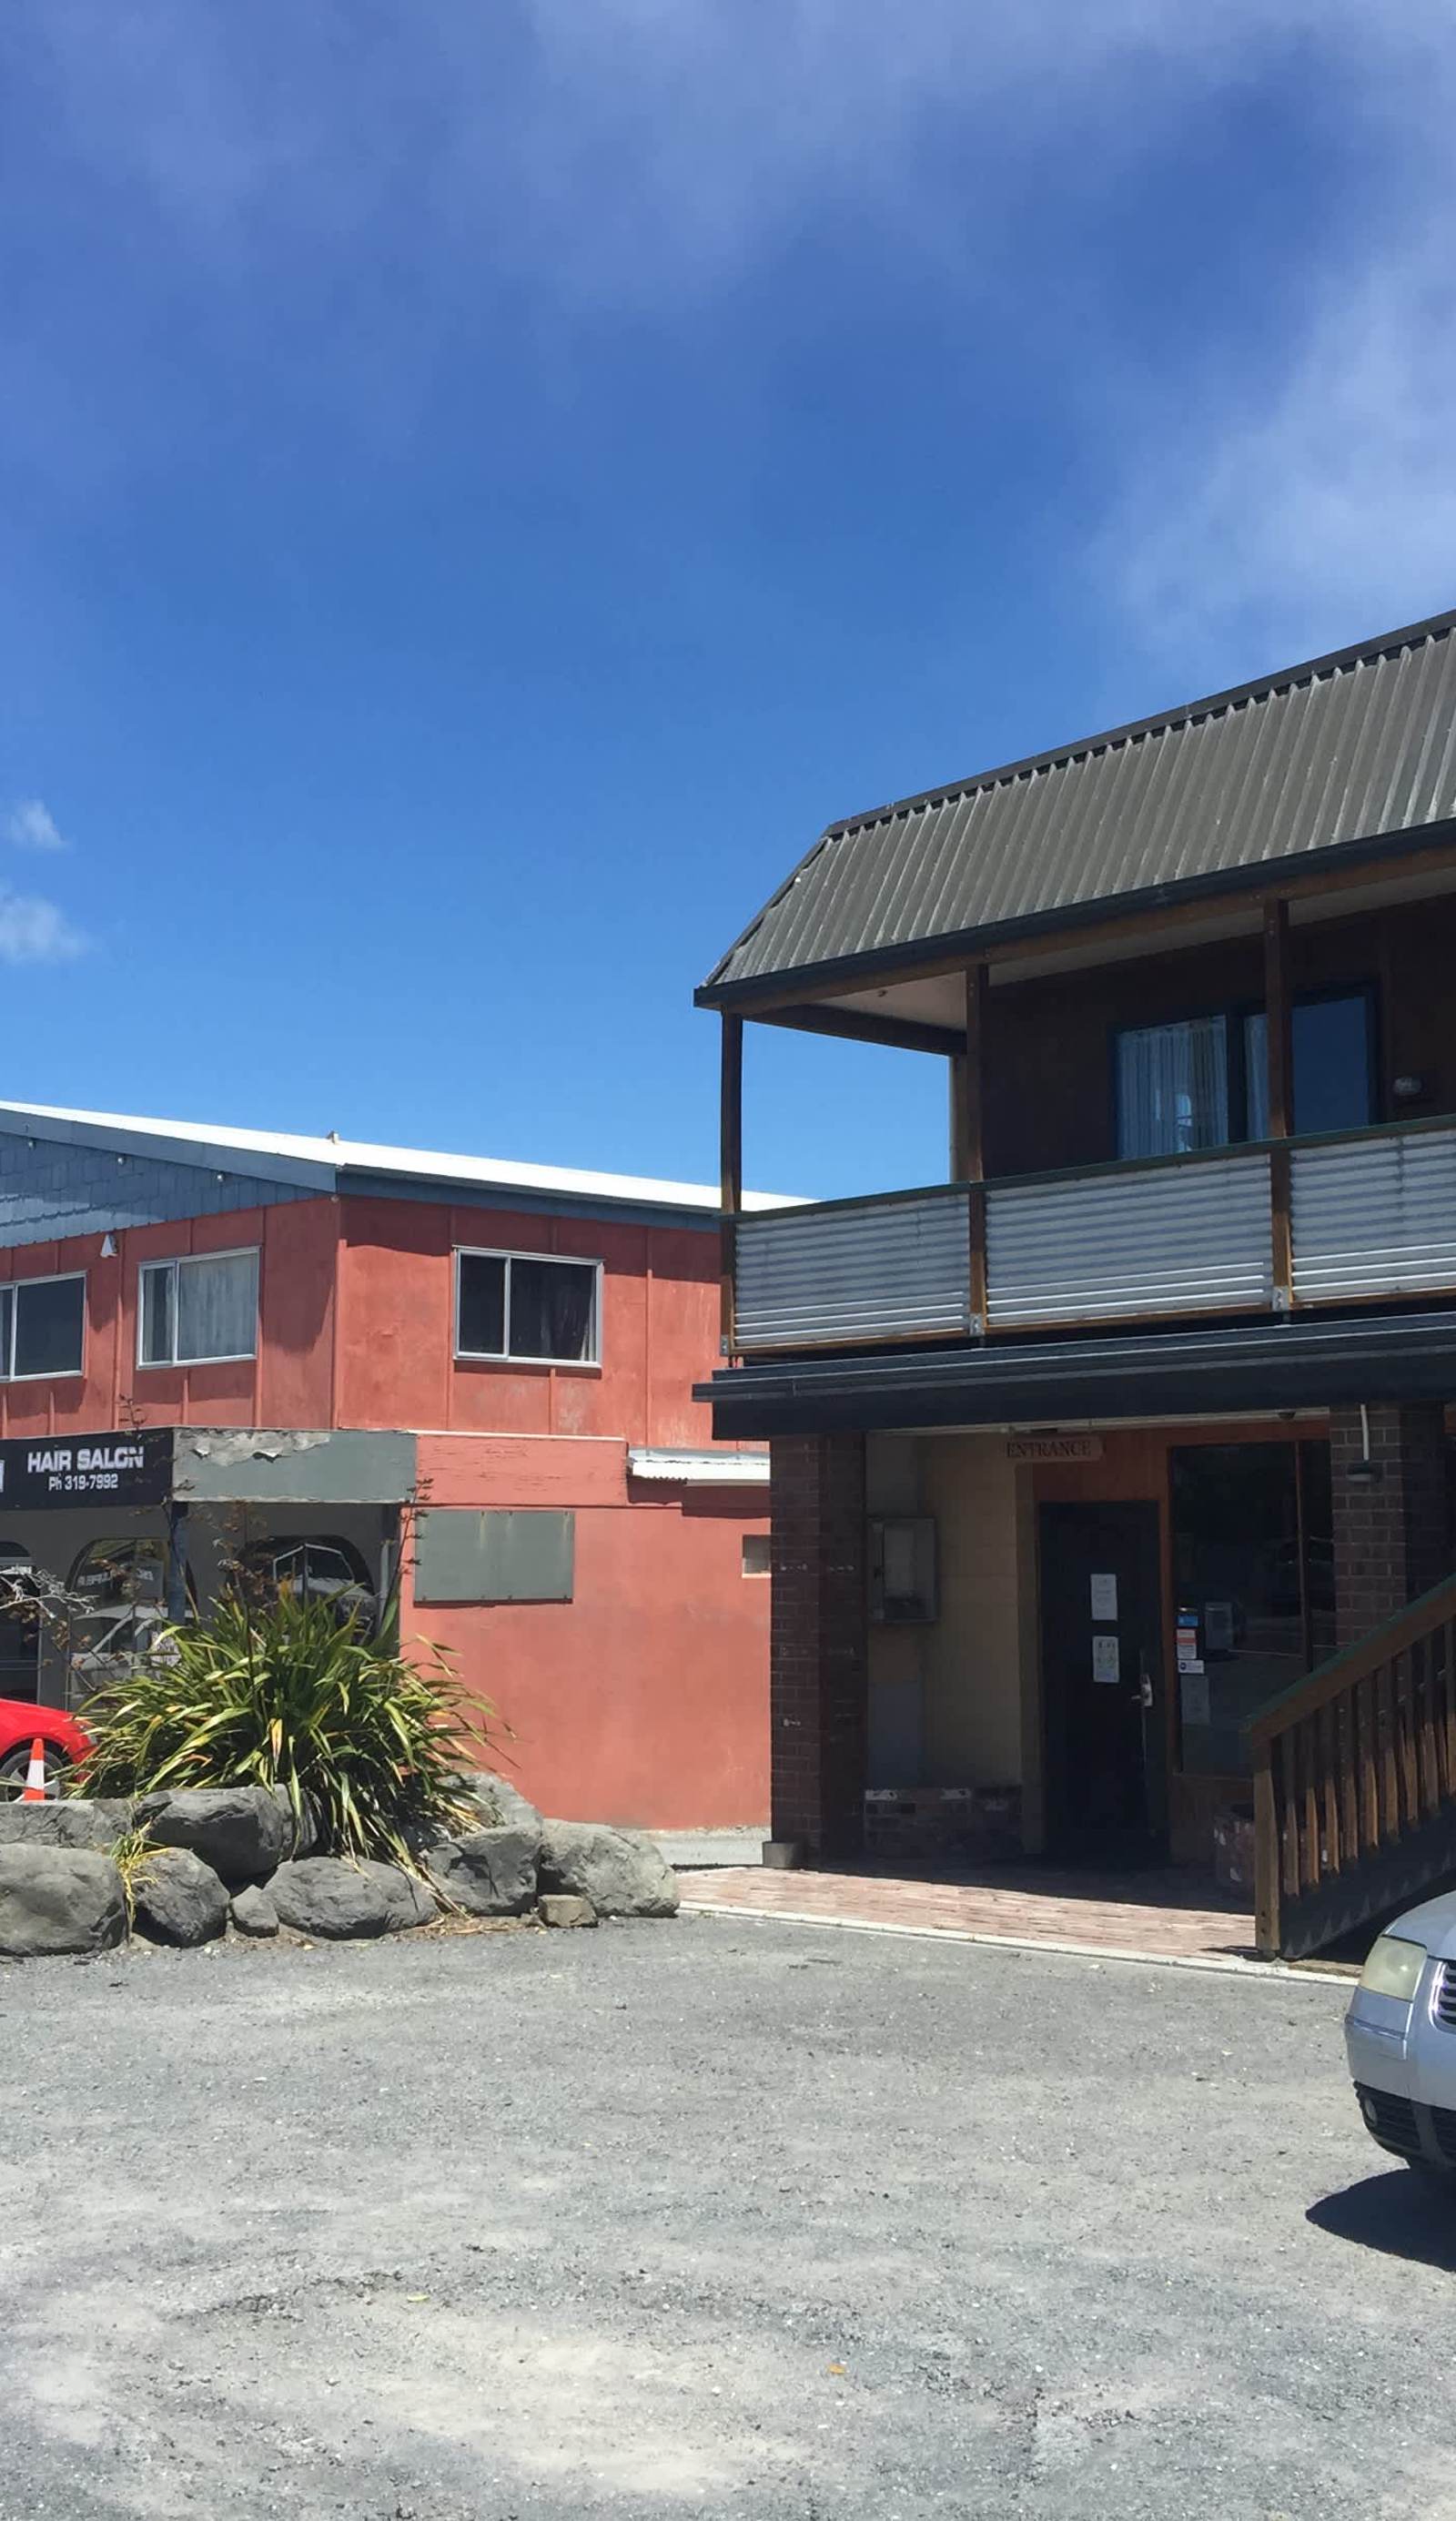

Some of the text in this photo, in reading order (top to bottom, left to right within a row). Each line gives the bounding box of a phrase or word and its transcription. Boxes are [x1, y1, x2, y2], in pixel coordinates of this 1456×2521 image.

[1006, 1440, 1092, 1458] ENTRANCE
[27, 1446, 144, 1473] HAIR SALON
[48, 1473, 118, 1491] Ph 319-7992
